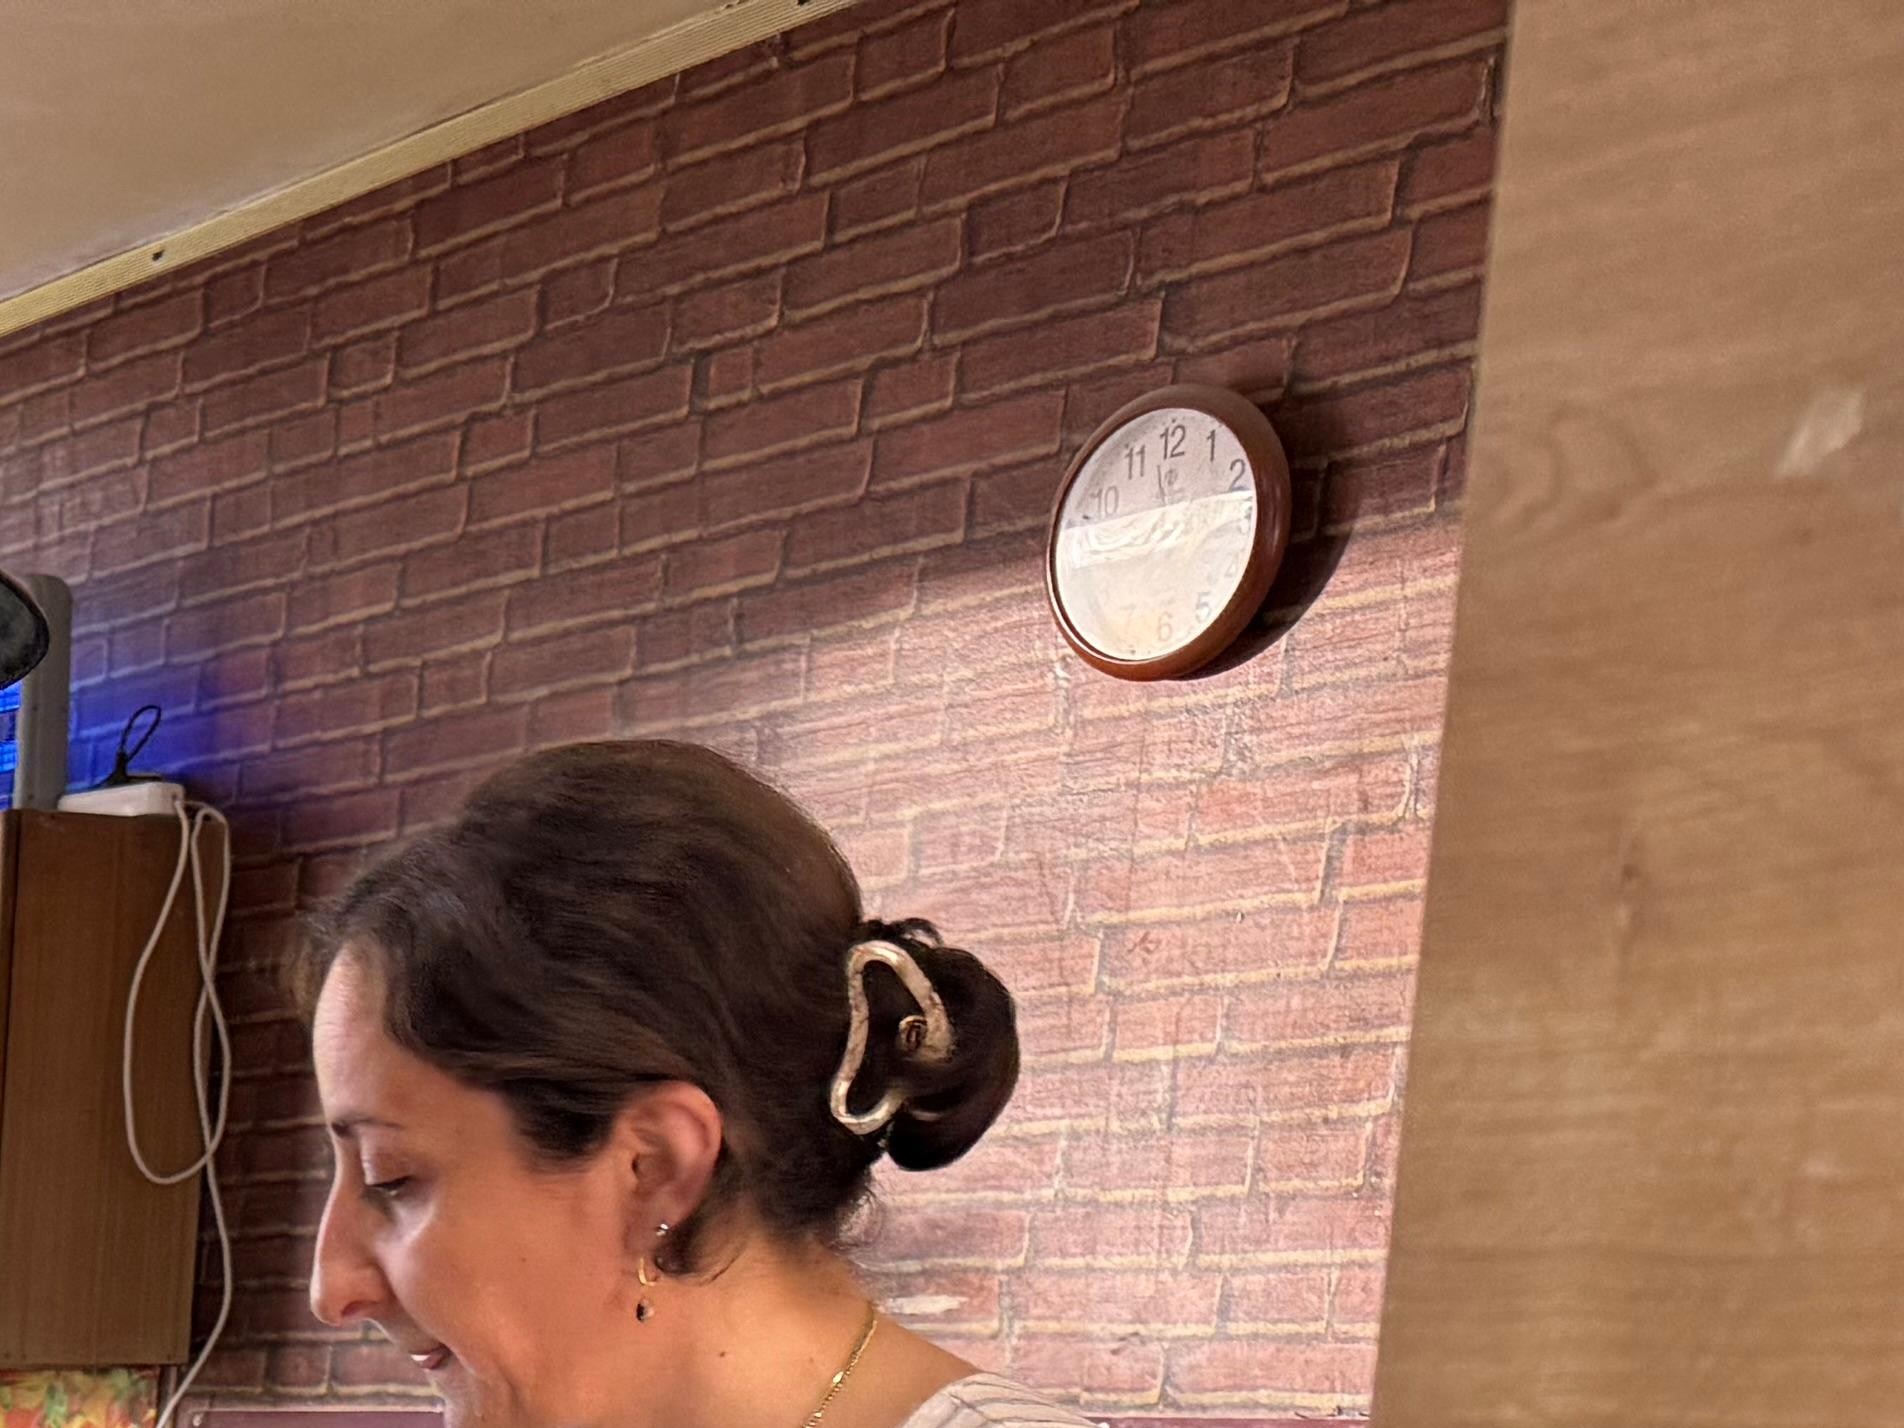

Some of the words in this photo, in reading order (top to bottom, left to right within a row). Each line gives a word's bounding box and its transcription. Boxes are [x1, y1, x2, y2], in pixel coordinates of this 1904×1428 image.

[1159, 424, 1187, 460] 12
[1206, 429, 1217, 462] 1
[1124, 444, 1146, 479] 11
[1229, 458, 1246, 491] 2
[1090, 485, 1120, 518] 10
[1194, 591, 1212, 624] 5
[1156, 612, 1174, 643] 6
